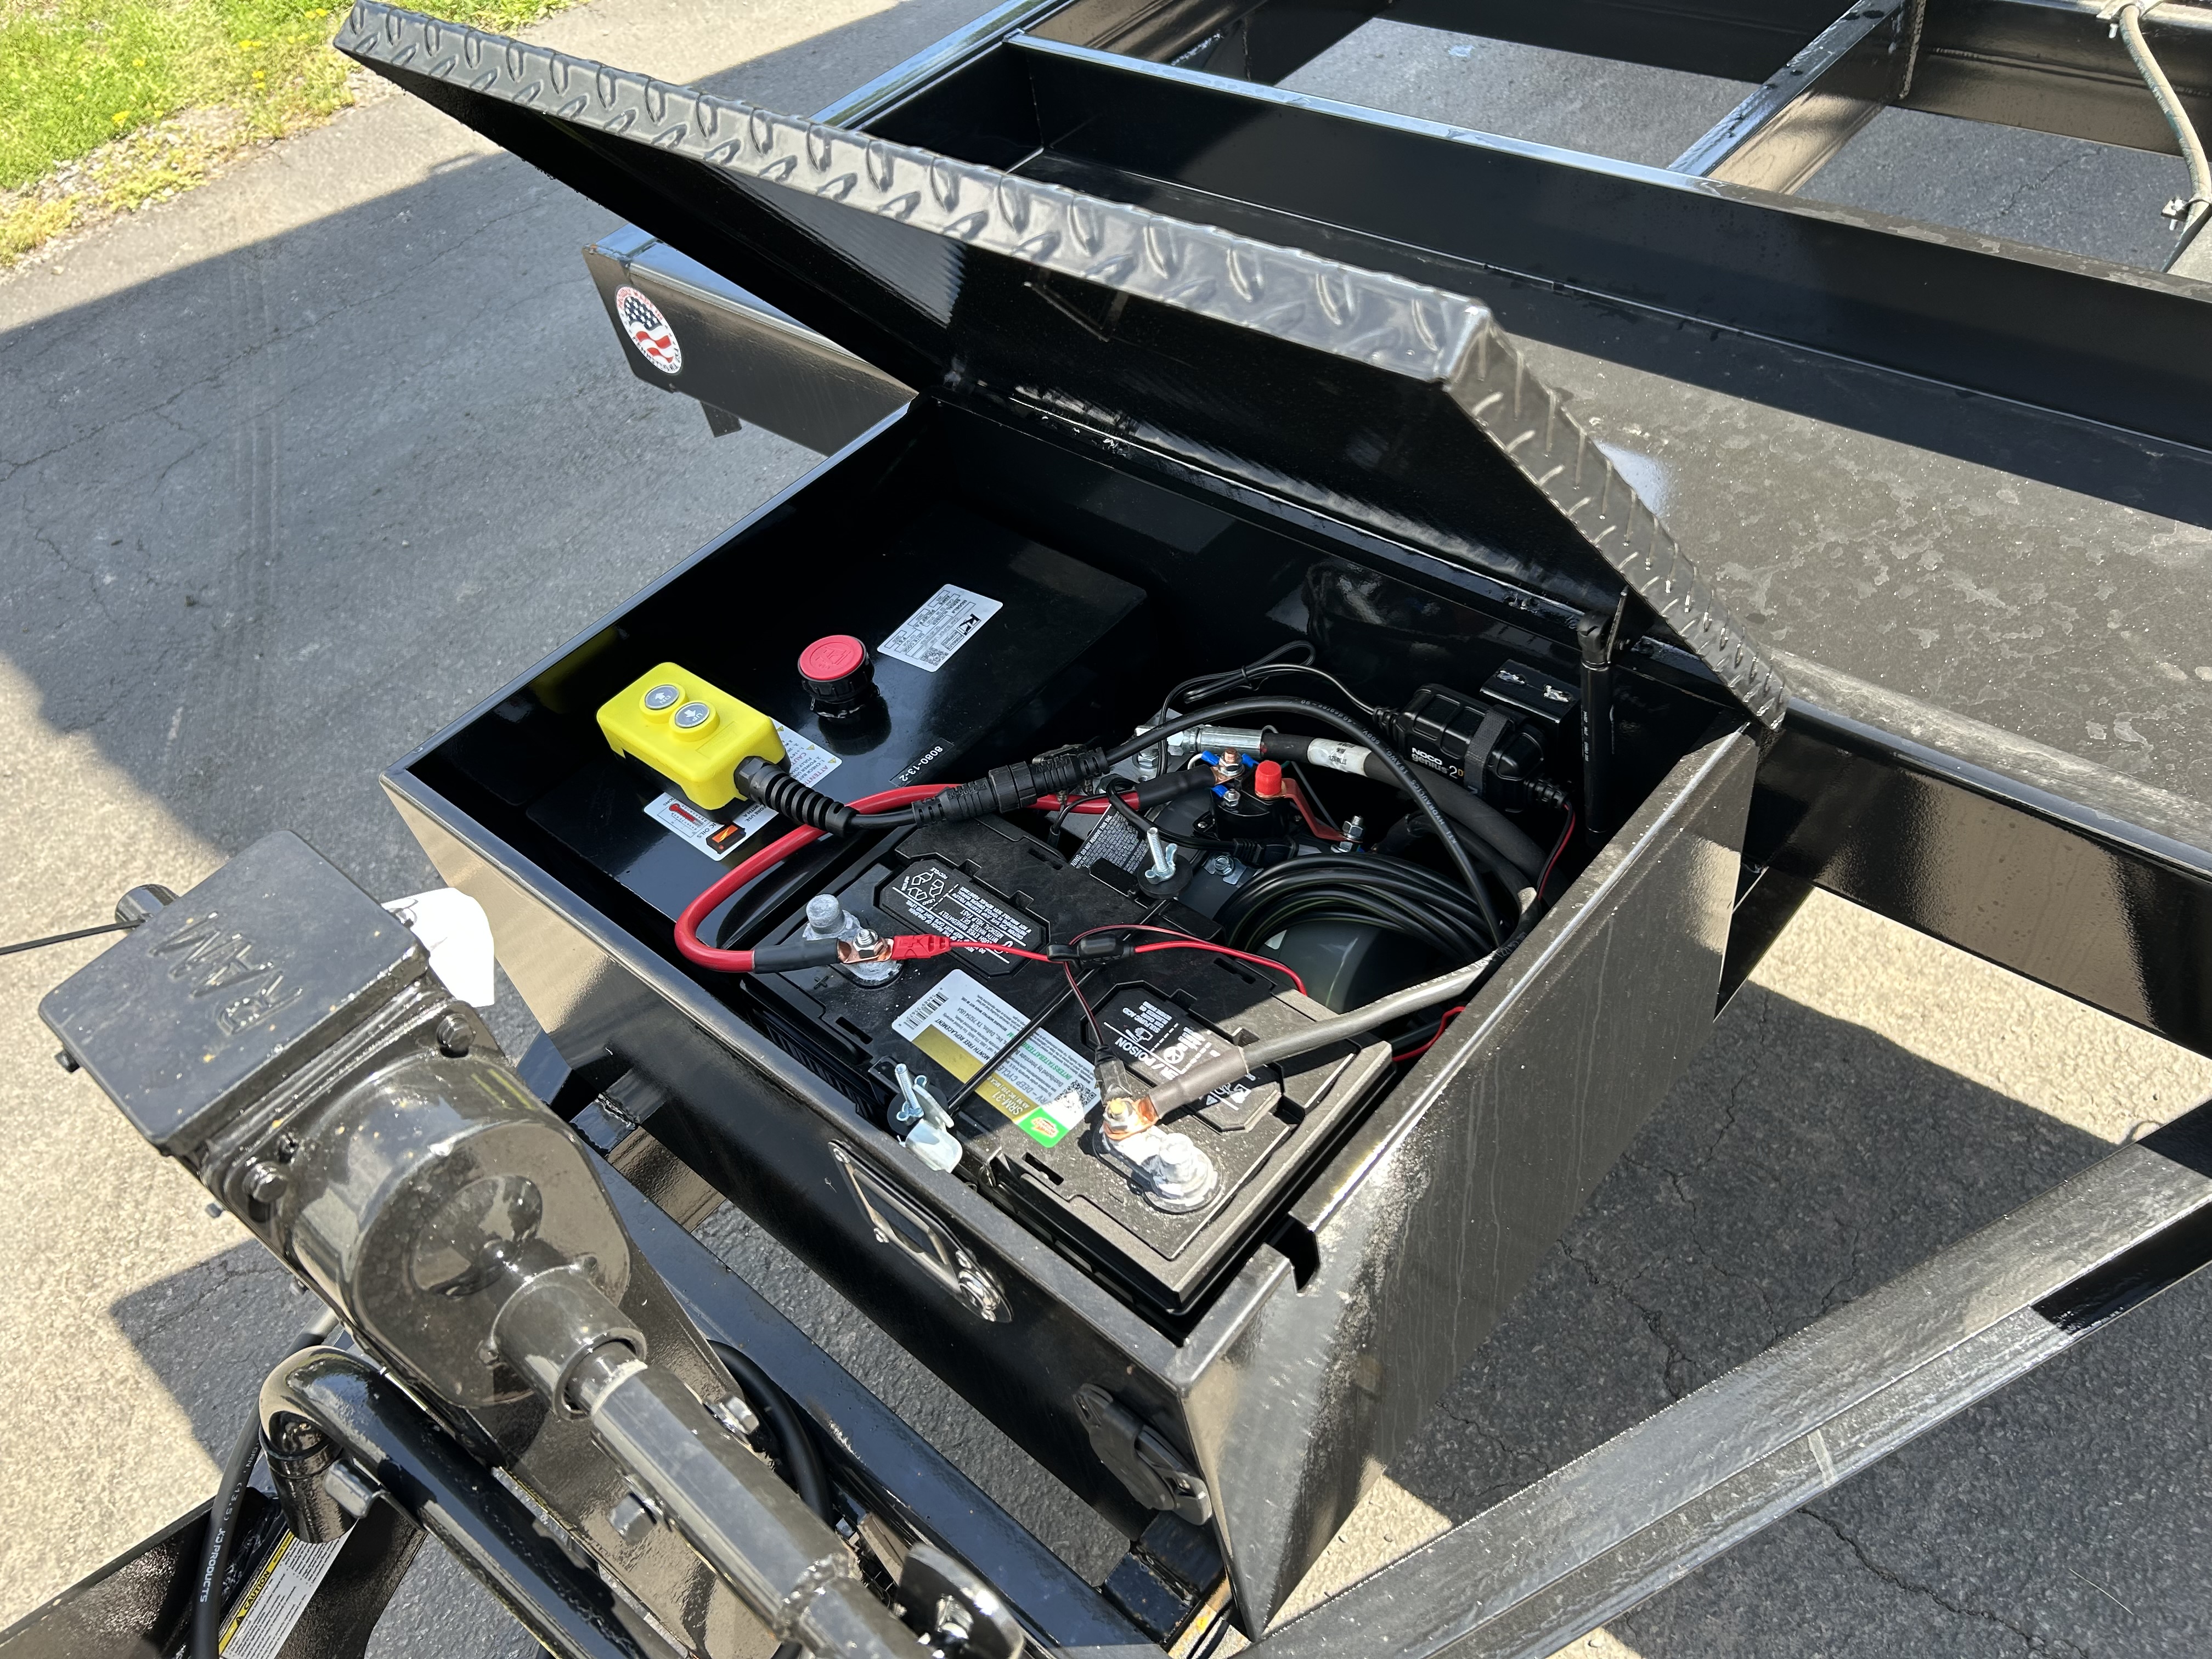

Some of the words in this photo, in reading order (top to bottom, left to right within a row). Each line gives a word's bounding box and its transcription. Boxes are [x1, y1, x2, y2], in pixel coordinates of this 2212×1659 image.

[658, 693, 672, 704] DN
[690, 711, 703, 723] UP
[797, 757, 812, 768] FULLY
[1411, 747, 1443, 765] NOCO
[800, 759, 816, 772] POWER
[805, 762, 821, 774] CHECK
[898, 745, 944, 782] 8080-13-2
[1411, 753, 1448, 774] genius
[801, 764, 830, 786] ATTENTI
[1410, 779, 1445, 825] HYDRAULICS
[695, 827, 711, 839] OILS
[1446, 831, 1457, 844] KTI
[1069, 854, 1083, 867] NING:
[1084, 842, 1092, 850] NOT
[1088, 829, 1102, 843] REMOVE
[1098, 821, 1108, 831] THIS
[929, 866, 949, 879] RECYCLE
[901, 876, 910, 890] RETURN
[950, 891, 967, 904] FOLLOW
[959, 908, 974, 919] FAST
[963, 900, 983, 914] STARTING
[907, 907, 927, 921] CHILDREN
[938, 909, 969, 931] IMMEDIATELY
[959, 915, 972, 925] GET
[1001, 912, 1021, 926] AVAILABLE
[929, 921, 944, 932] REACH
[933, 917, 946, 927] CAPS
[970, 915, 985, 927] HELP
[944, 924, 955, 933] VENT
[966, 927, 980, 938] EYES
[982, 923, 1005, 939] MEDICAL
[985, 932, 1000, 943] WITH
[956, 1006, 967, 1015] USA
[1120, 1006, 1137, 1018] ACID
[963, 1012, 978, 1024] 75254
[1133, 1014, 1161, 1034] SULFURIC
[934, 1017, 965, 1041] REPLACEMENT
[962, 1038, 975, 1049] FREE
[972, 1046, 992, 1062] -MONTH
[1018, 1051, 1038, 1069] Interstate
[996, 1064, 1019, 1083] CYCLE
[1041, 1068, 1064, 1087] Distributed
[990, 1077, 1002, 1087] MCA
[1014, 1077, 1034, 1094] DEEP
[991, 1089, 1024, 1116] SRM-31
[200, 1544, 219, 1603] PRODUCTS
[244, 1571, 270, 1610] CAUTION
